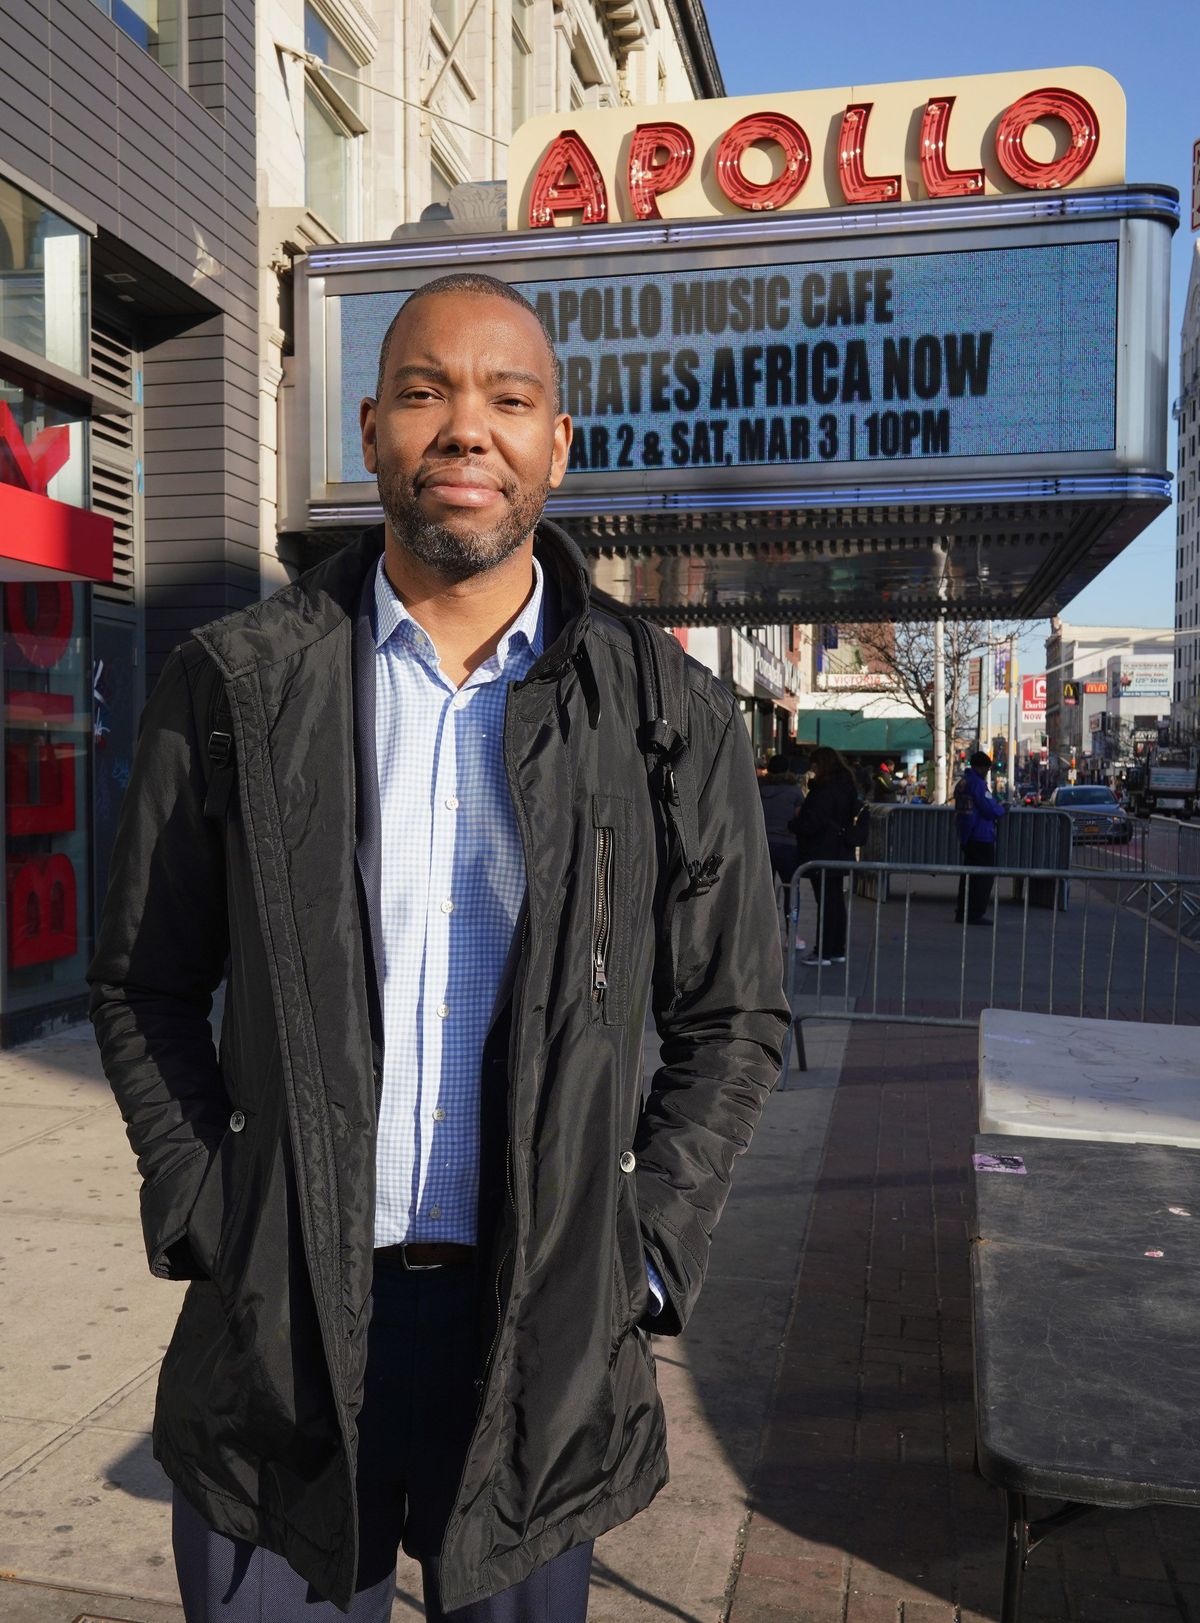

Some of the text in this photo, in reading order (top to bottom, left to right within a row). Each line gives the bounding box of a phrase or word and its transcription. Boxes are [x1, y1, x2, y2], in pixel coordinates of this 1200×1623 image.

[528, 87, 1101, 229] APOLLO
[533, 269, 894, 344] APOLLO MUSIC CAFE
[559, 331, 993, 417] RATES AFRICA NOW
[569, 424, 609, 469] AR
[617, 423, 634, 467] 2
[642, 431, 663, 466] &
[739, 414, 811, 463] MAR
[818, 412, 839, 460] 3
[864, 408, 950, 458] 10PM
